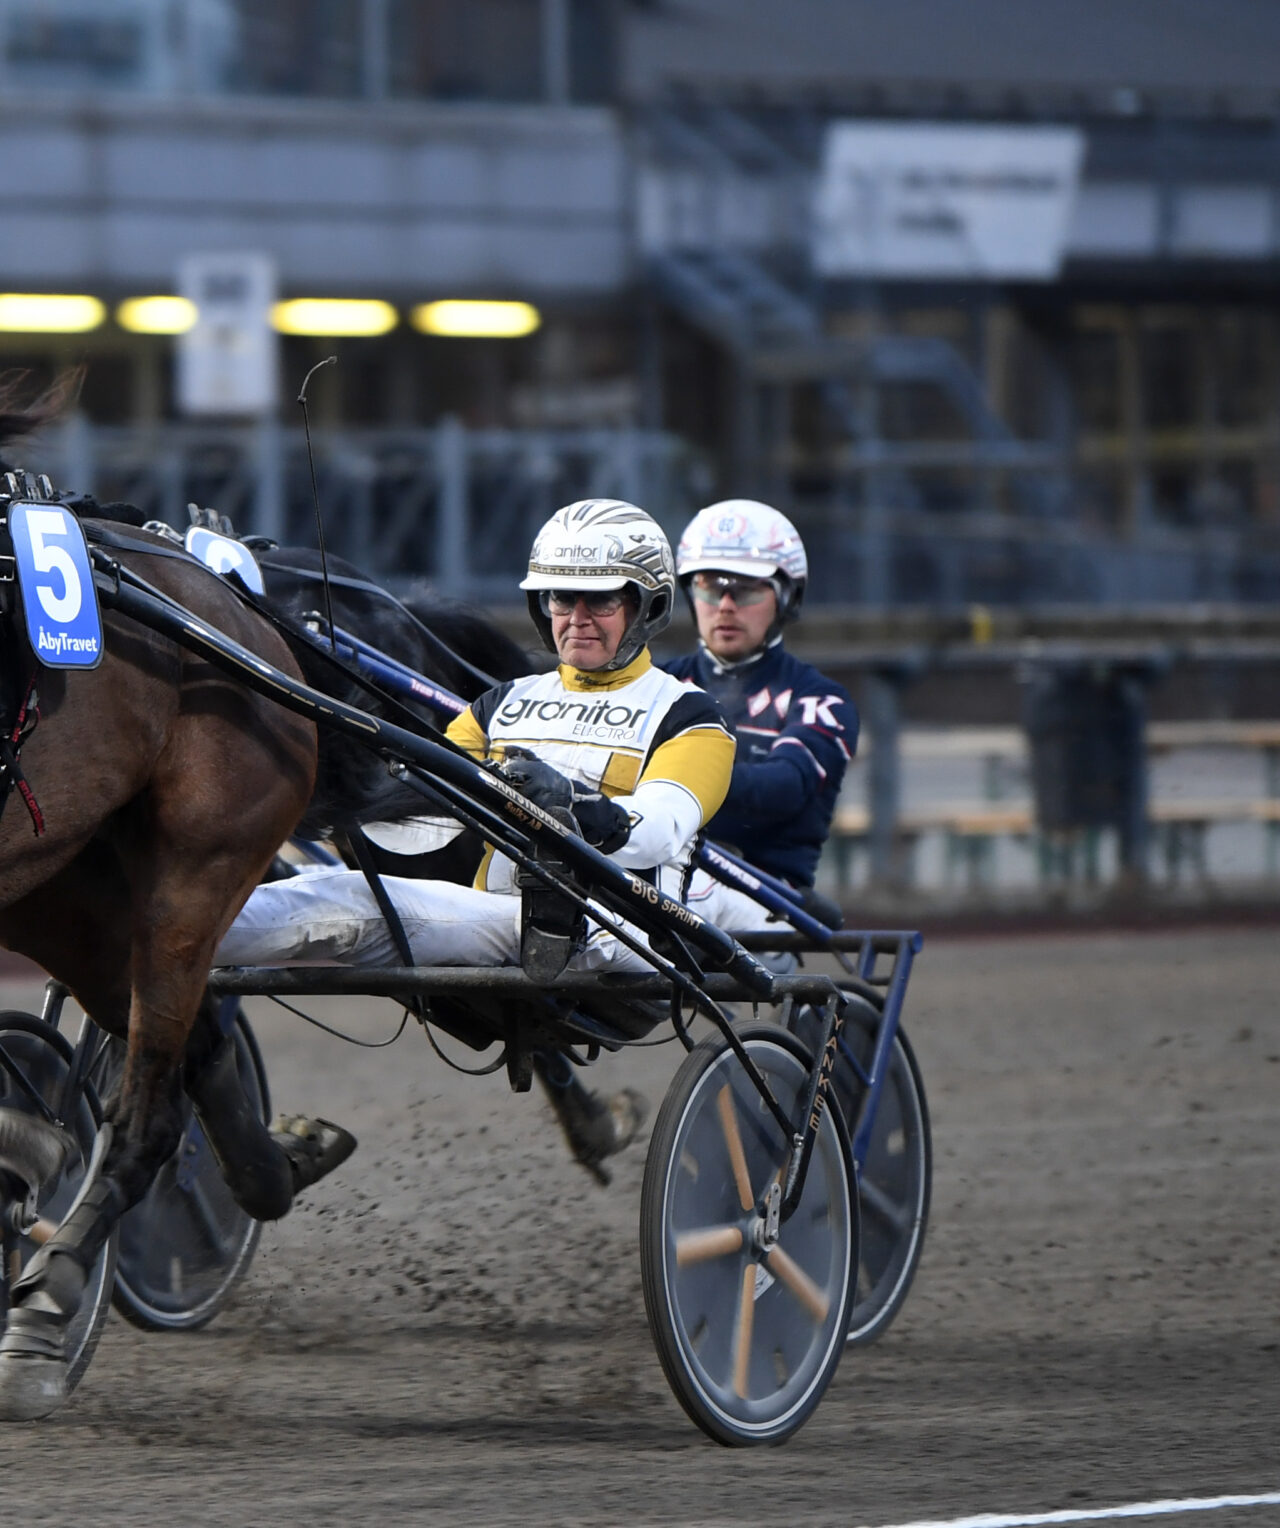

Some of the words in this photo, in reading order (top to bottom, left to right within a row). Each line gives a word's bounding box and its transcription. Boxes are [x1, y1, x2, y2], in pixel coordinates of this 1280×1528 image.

[25, 510, 82, 623] 5
[38, 626, 98, 655] ÅbyTravet
[497, 698, 648, 728] granitor
[572, 723, 635, 741] ELECTRO
[529, 818, 543, 831] AB
[661, 899, 705, 931] SPRINT
[809, 1013, 843, 1132] YANKEE
